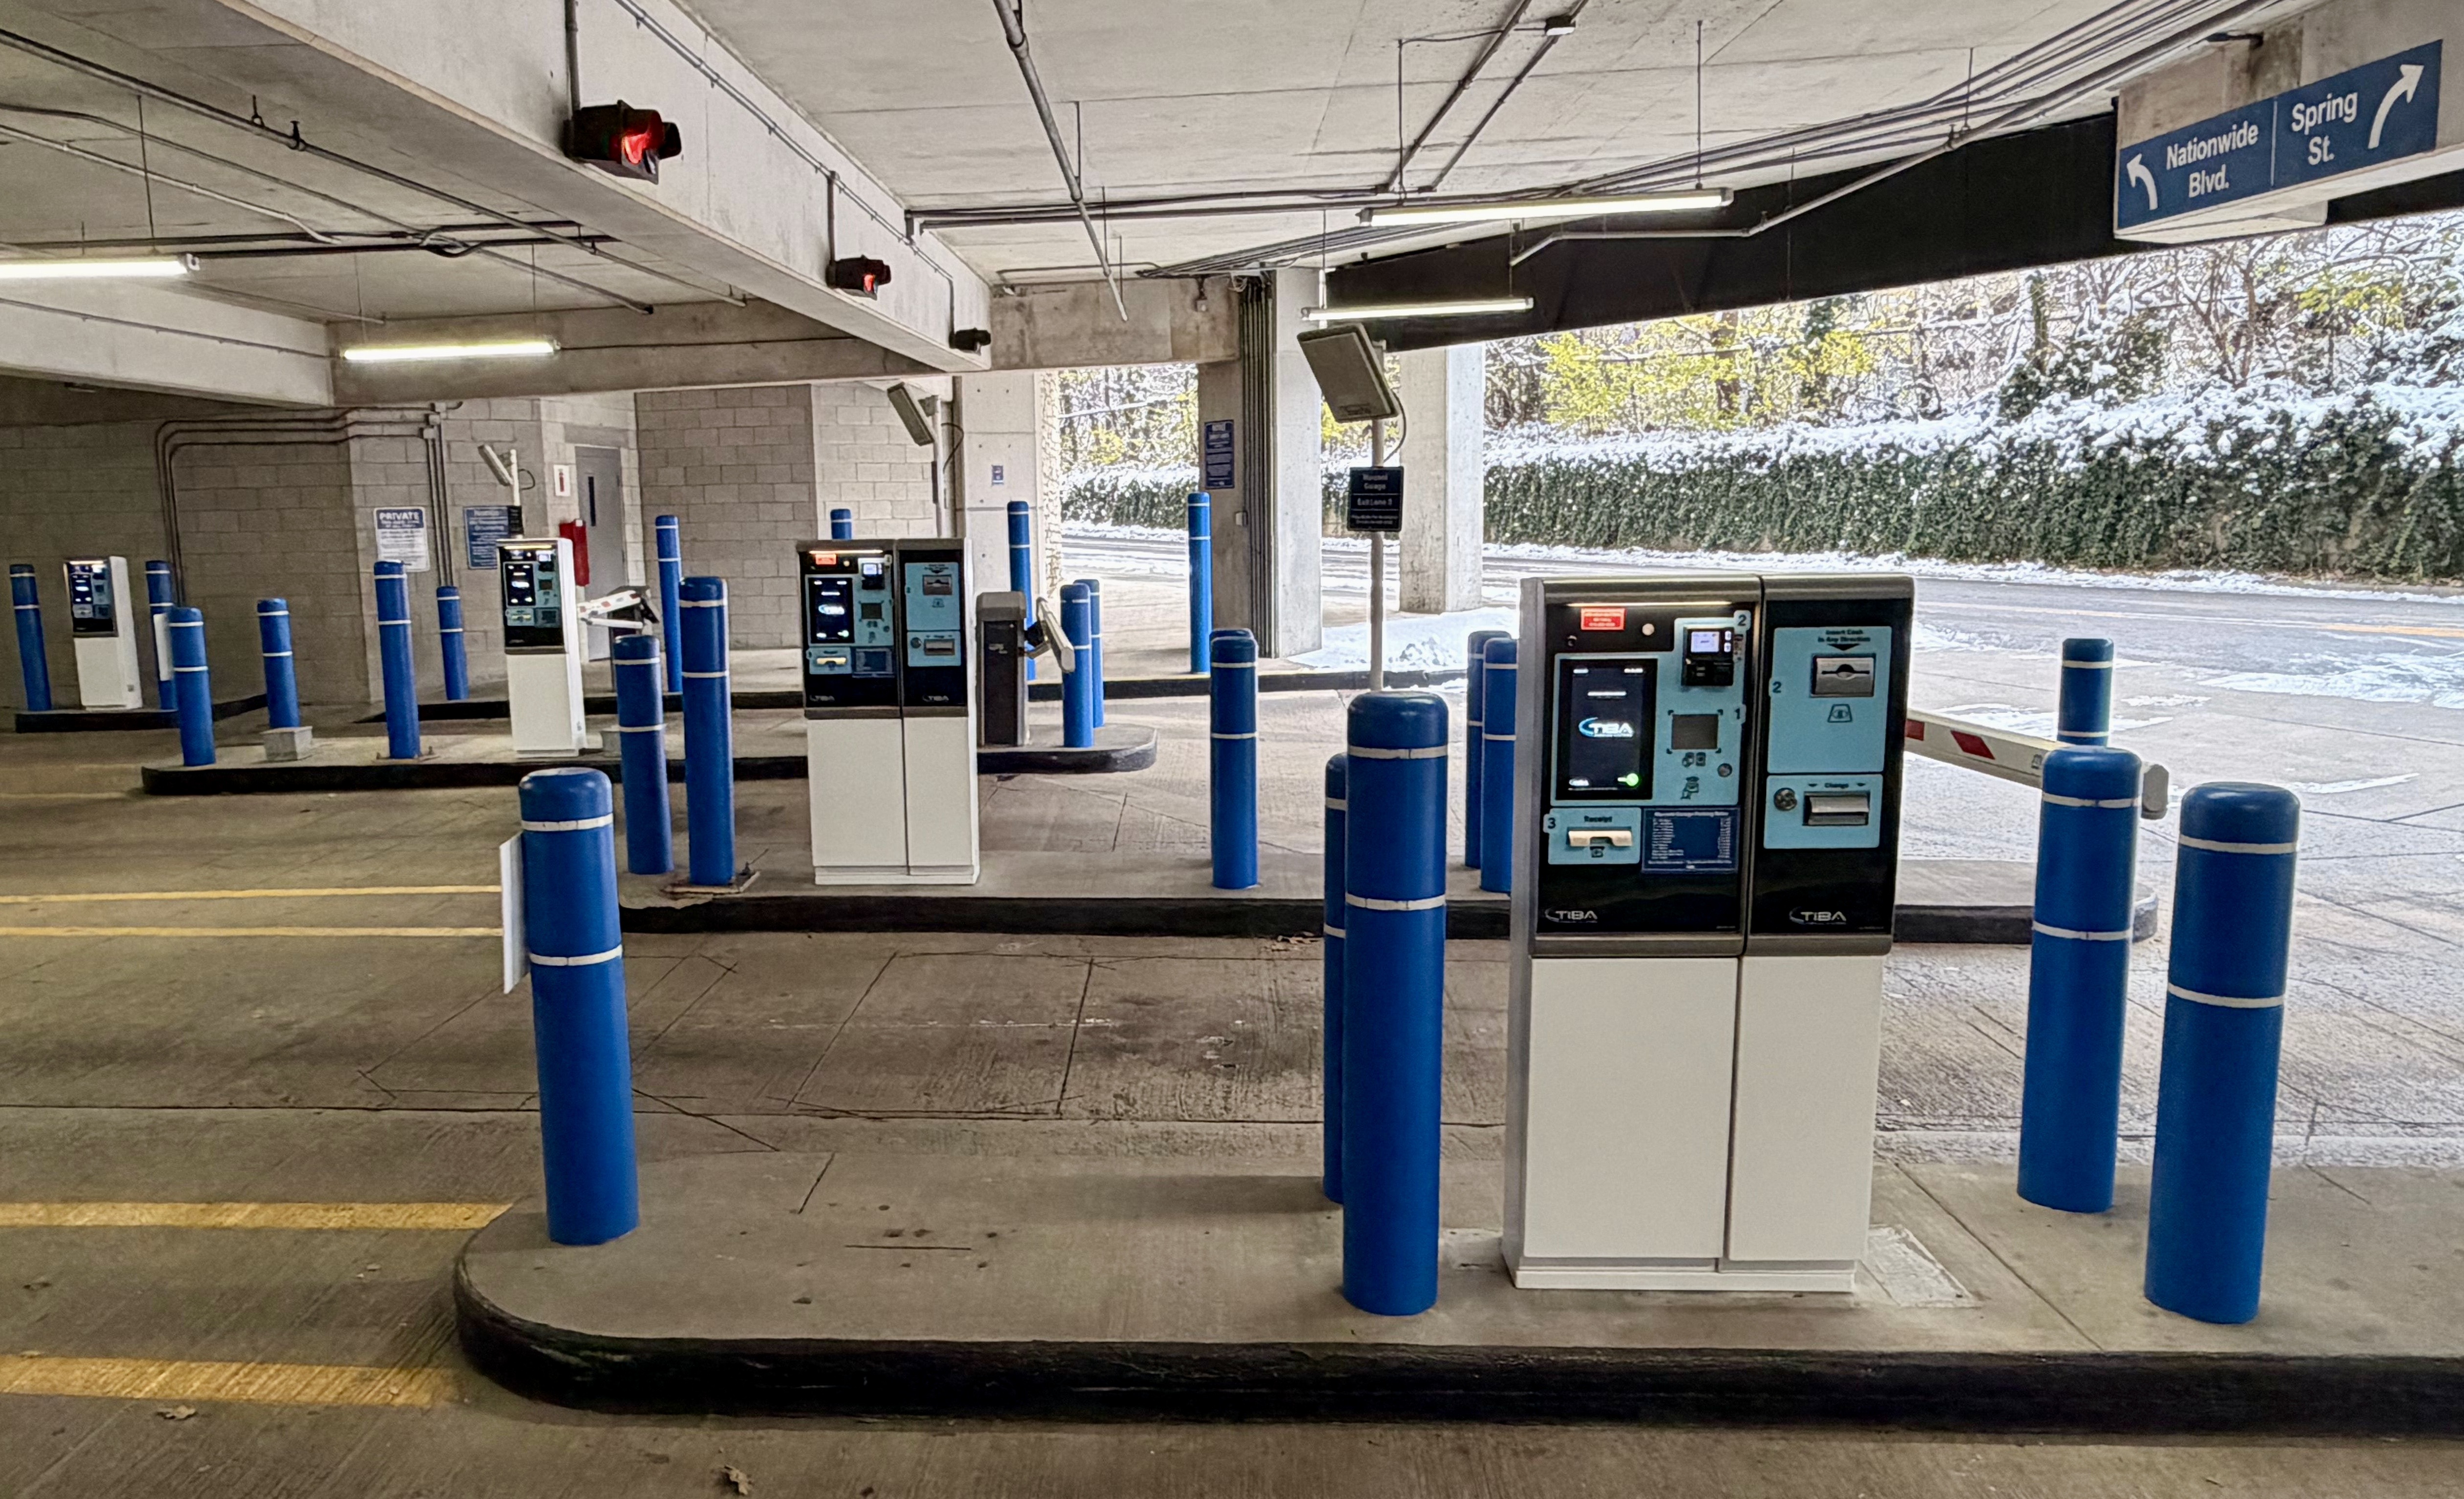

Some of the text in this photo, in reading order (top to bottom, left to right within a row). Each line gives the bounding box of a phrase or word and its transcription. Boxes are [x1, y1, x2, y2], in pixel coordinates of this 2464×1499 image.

[2292, 92, 2358, 135] Spring
[2166, 121, 2258, 170] Nationwide
[2308, 135, 2335, 166] St.
[2189, 164, 2230, 198] Blvd.
[379, 512, 420, 520] PRIVATE
[1737, 614, 1747, 626] 2
[1772, 681, 1782, 693] 2
[1734, 708, 1740, 720] 1
[1548, 817, 1557, 829] 3
[1555, 910, 1598, 920] TIBA
[1800, 911, 1847, 921] TIBA
